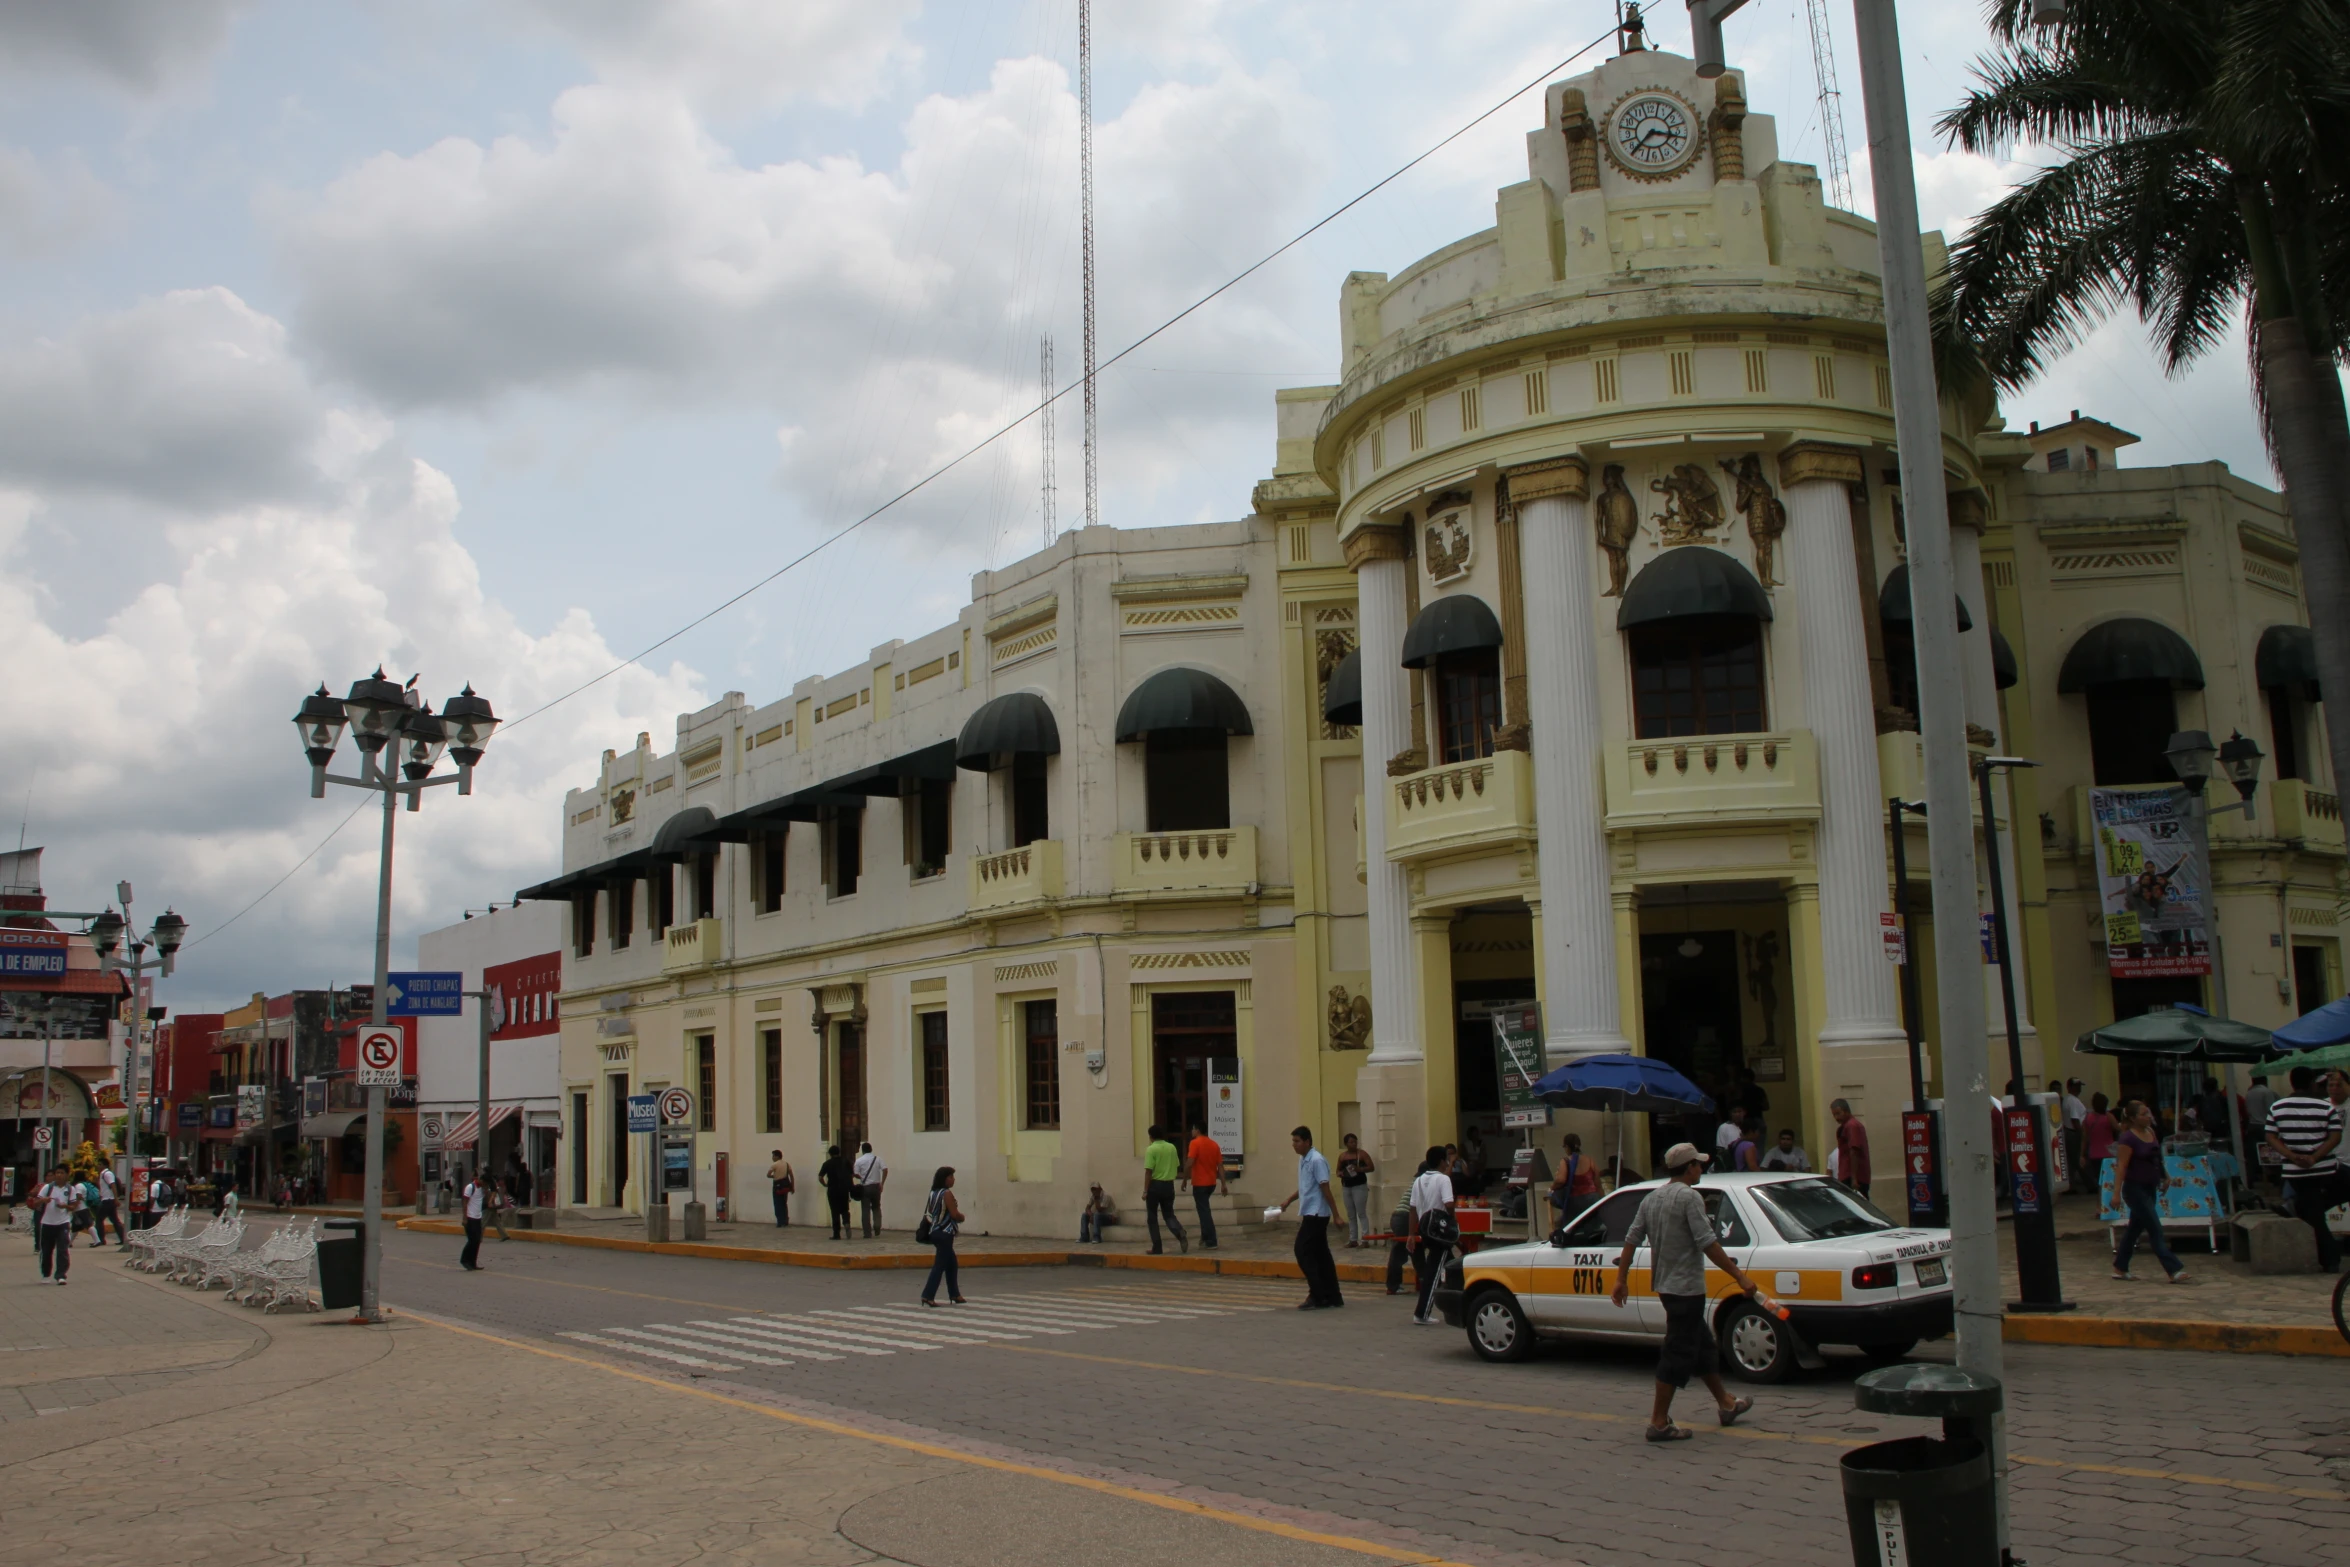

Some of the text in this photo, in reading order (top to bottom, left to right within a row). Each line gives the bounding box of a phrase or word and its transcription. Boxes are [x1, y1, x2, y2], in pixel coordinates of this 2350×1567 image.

[1634, 109, 1643, 117] 11
[1647, 104, 1655, 113] 12
[1661, 108, 1665, 116] 1
[1625, 118, 1634, 127] 10
[1669, 115, 1676, 124] 2
[1625, 130, 1631, 139] 9
[1639, 149, 1645, 157] 7
[1651, 151, 1657, 160] 6
[1664, 148, 1670, 156] 5
[2093, 789, 2171, 808] ENTREGA
[2096, 808, 2117, 821] DE
[2119, 802, 2174, 819] FICHAS
[2149, 822, 2180, 839] UP
[2119, 844, 2133, 856] 09
[2121, 856, 2135, 867] 27
[2117, 867, 2143, 875] MAYO
[2166, 886, 2177, 902] 3
[0, 934, 61, 945] ORAL
[2109, 927, 2126, 942] 25
[6, 954, 21, 970] DE
[23, 955, 64, 972] EMPLEO
[2142, 959, 2149, 967] al
[2150, 957, 2175, 967] celular
[408, 979, 459, 992] PUERTO CHIAPAS
[408, 996, 459, 1009] ZONA DE MANGLARES
[628, 1100, 656, 1118] MUSEO
[1907, 1119, 1925, 1130] Habla
[2010, 1117, 2029, 1127] Habla
[1912, 1132, 1922, 1141] sin
[2016, 1129, 2026, 1139] sin
[1574, 1253, 1603, 1266] TAXI
[1573, 1268, 1603, 1294] 0716
